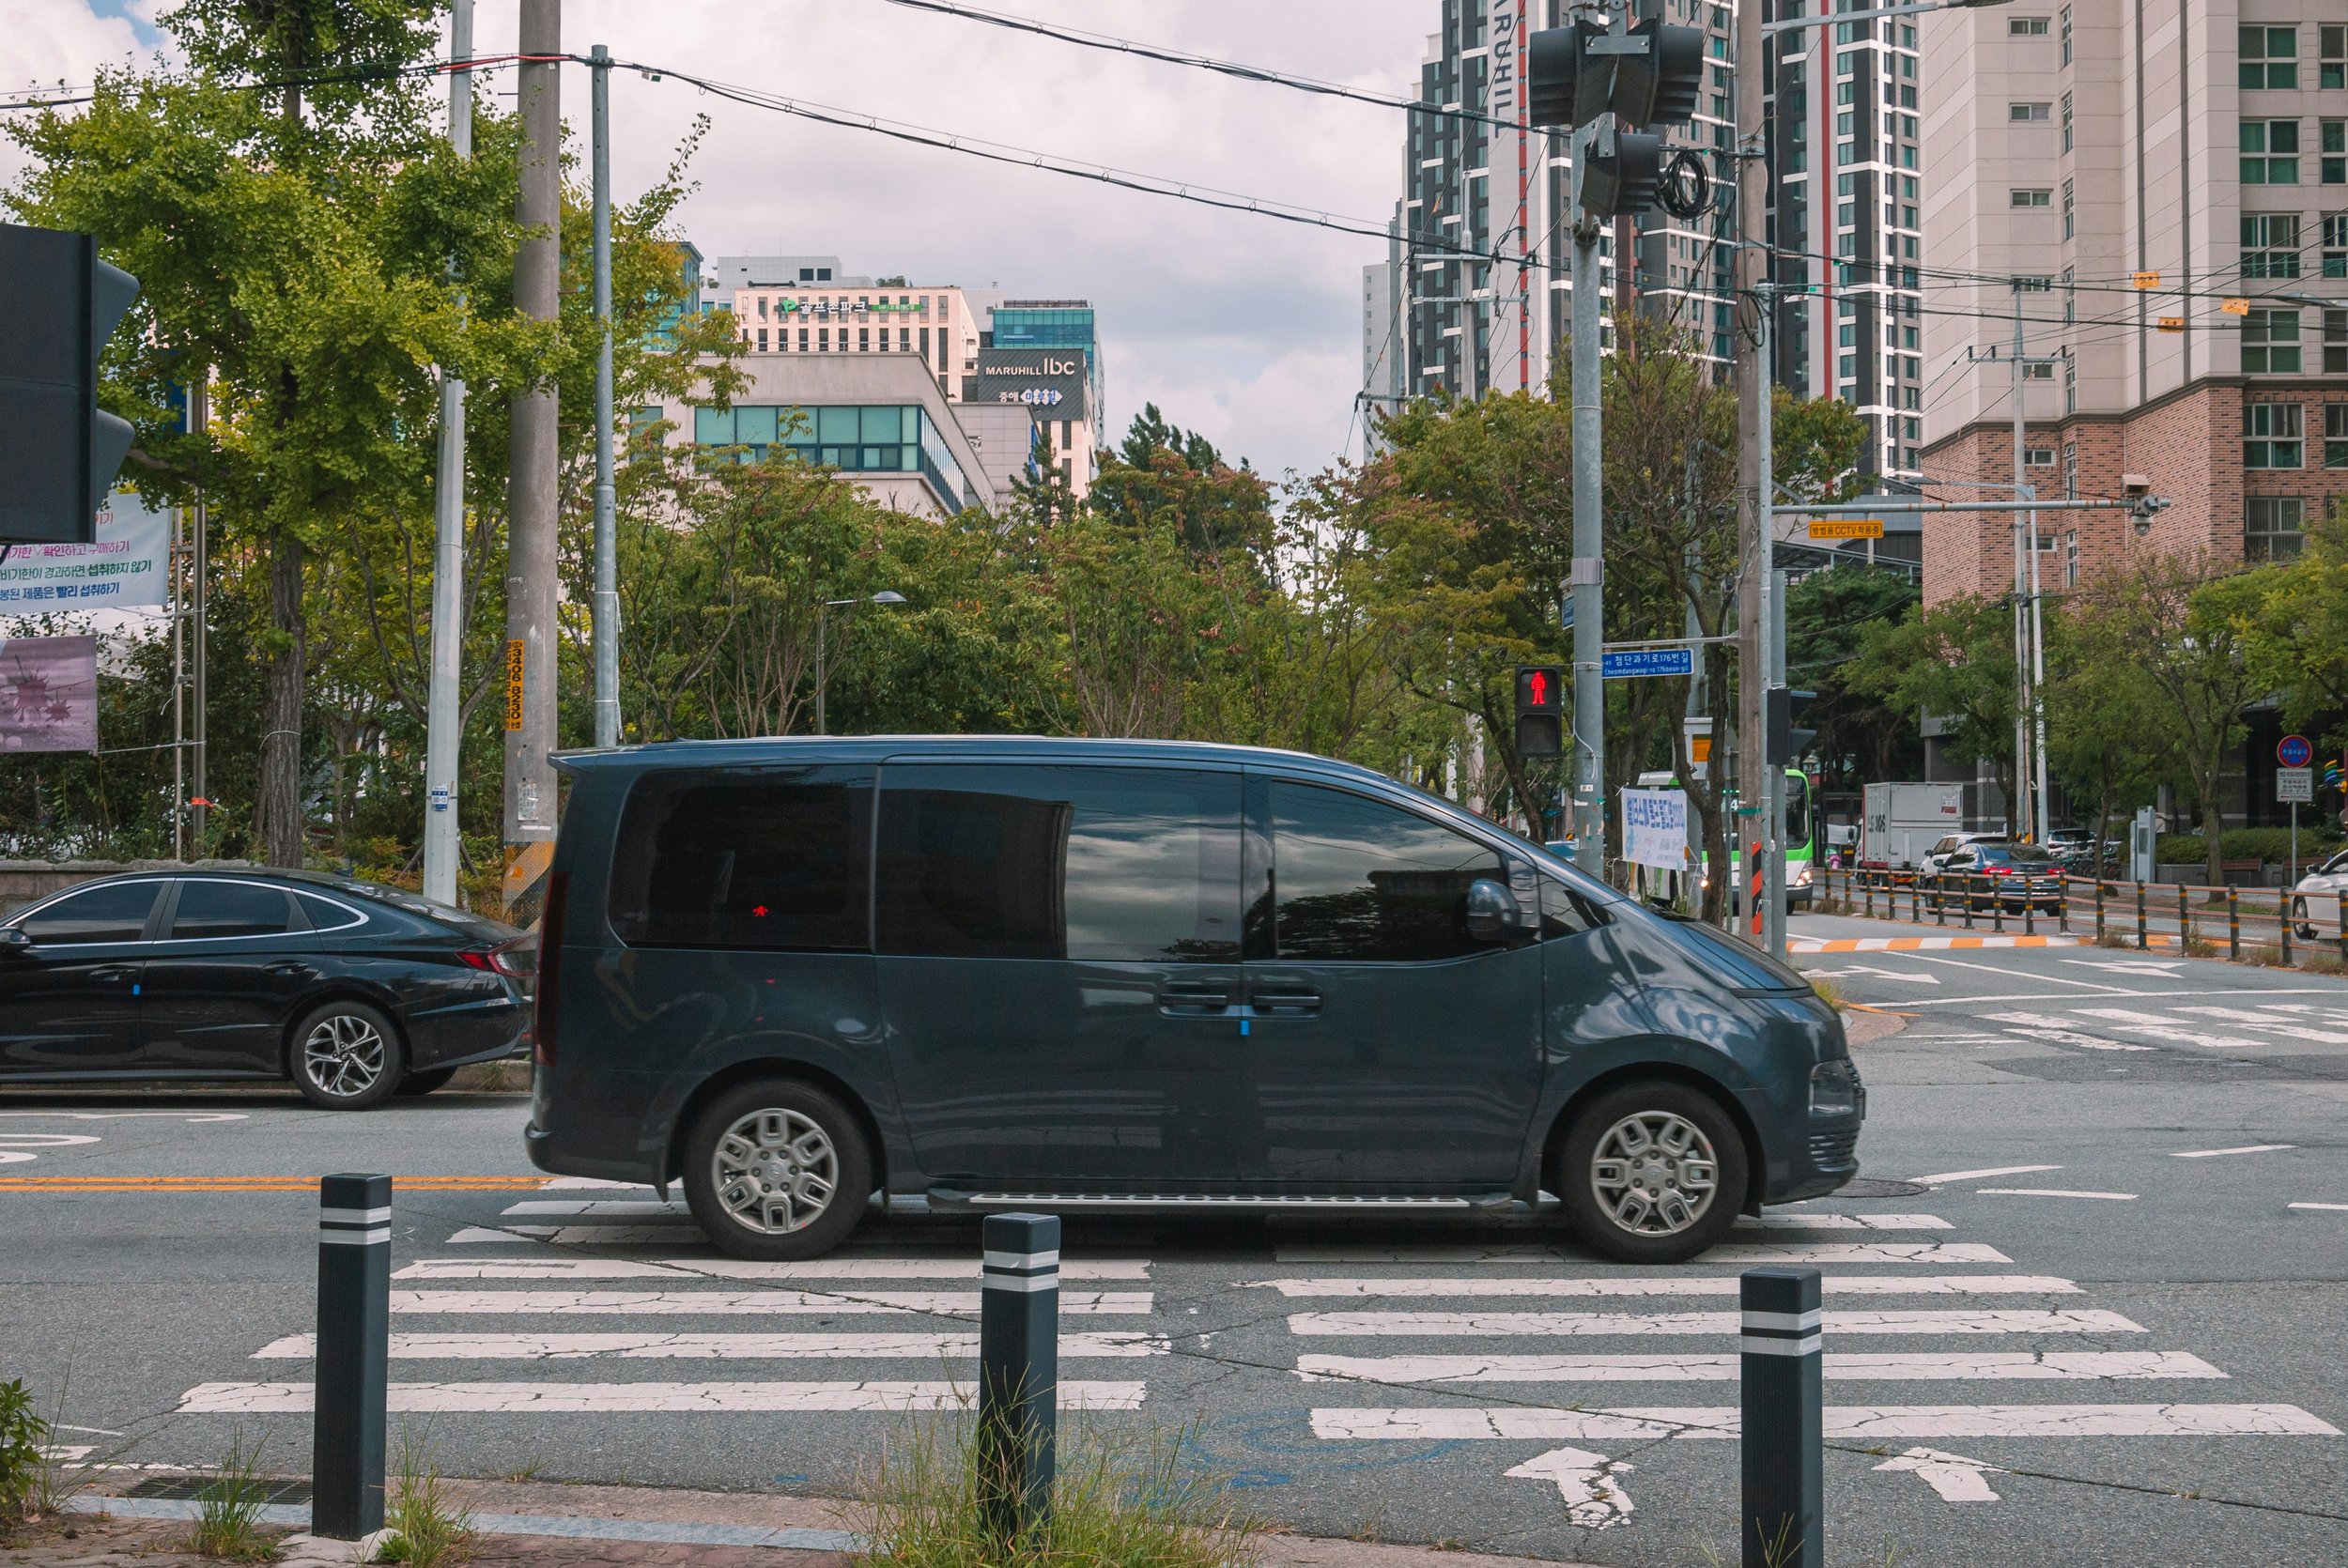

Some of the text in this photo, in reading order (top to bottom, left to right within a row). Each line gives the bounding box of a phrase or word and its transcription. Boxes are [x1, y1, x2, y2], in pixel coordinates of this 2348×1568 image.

[986, 367, 1042, 376] MARUHILL
[43, 545, 86, 557] 확인하고
[89, 541, 130, 553] 구매하기
[45, 565, 85, 578] 경과하면
[88, 562, 129, 576] 섭취하지
[131, 561, 151, 573] 않기
[0, 582, 120, 601] 봉된 제품은 빨리 섭취하기
